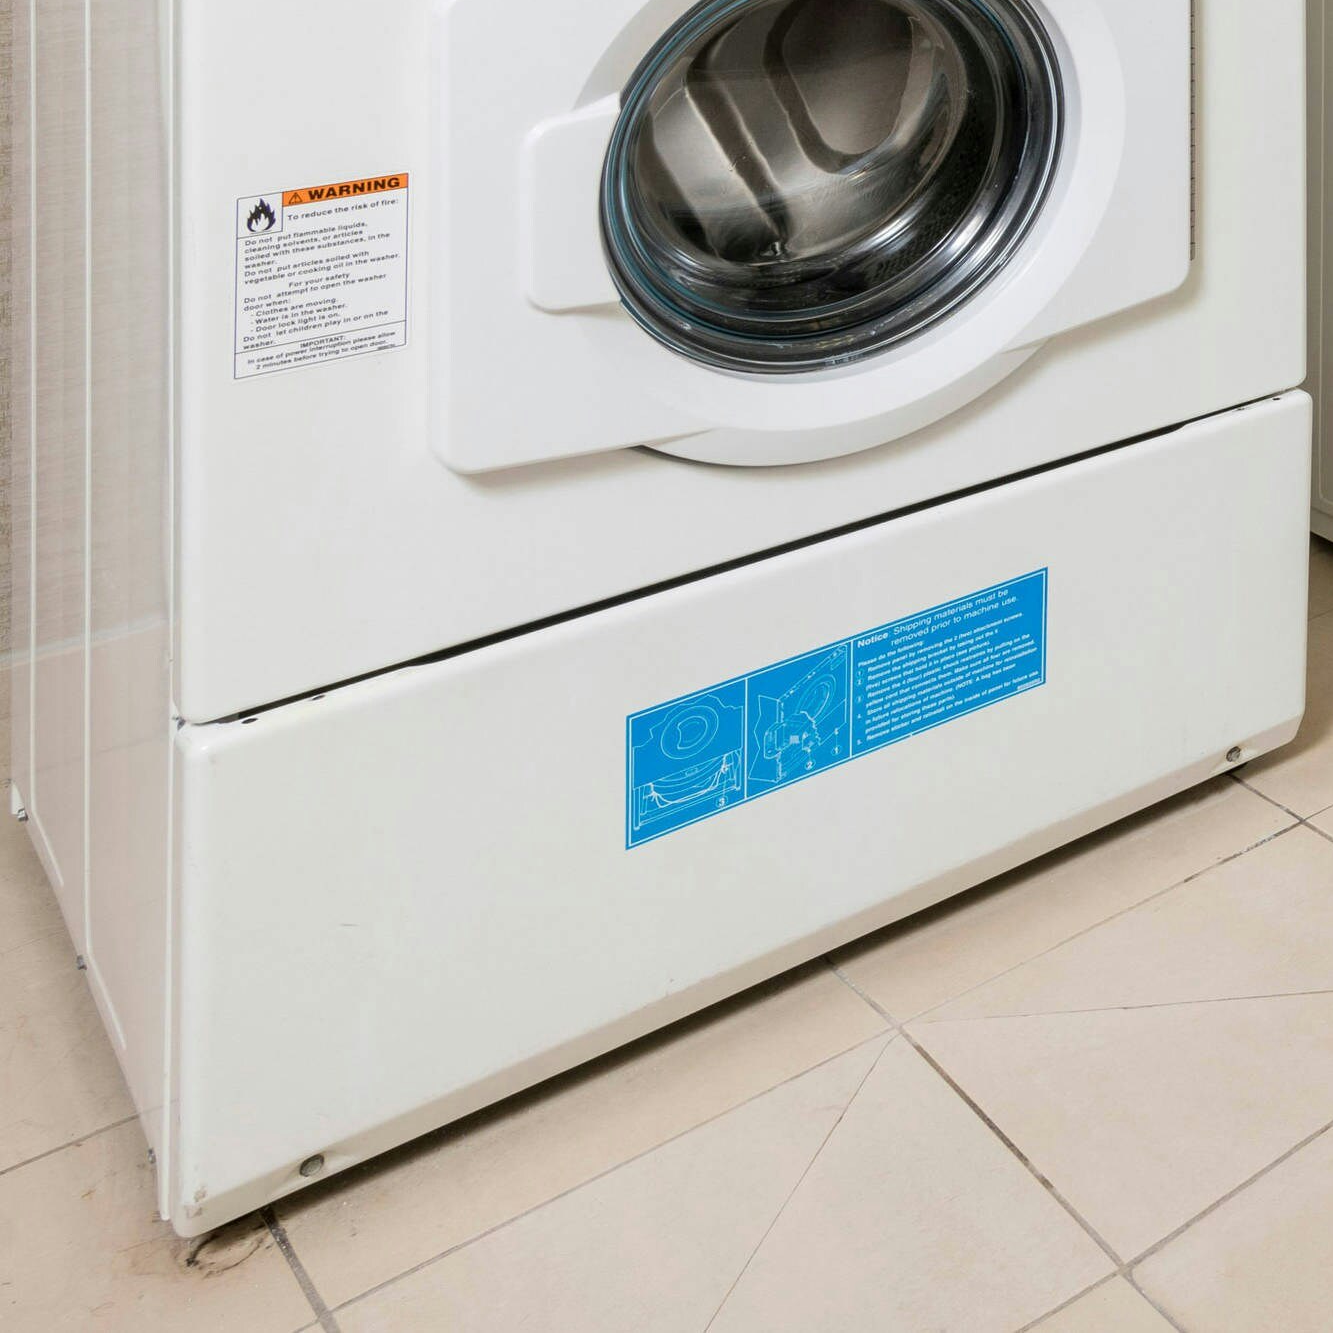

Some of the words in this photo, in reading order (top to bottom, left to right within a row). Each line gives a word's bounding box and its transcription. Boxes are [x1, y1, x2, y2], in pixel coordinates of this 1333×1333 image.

[308, 177, 400, 200] WARNING
[301, 208, 332, 219] reduce
[351, 202, 368, 210] risk
[858, 632, 889, 648] Notice
[893, 617, 932, 635] Shipping
[934, 602, 973, 620] materials
[975, 593, 996, 605] must
[998, 589, 1008, 597] be
[891, 628, 929, 645] removed
[931, 620, 951, 633] prior
[953, 615, 962, 623] to
[964, 604, 998, 619] machine
